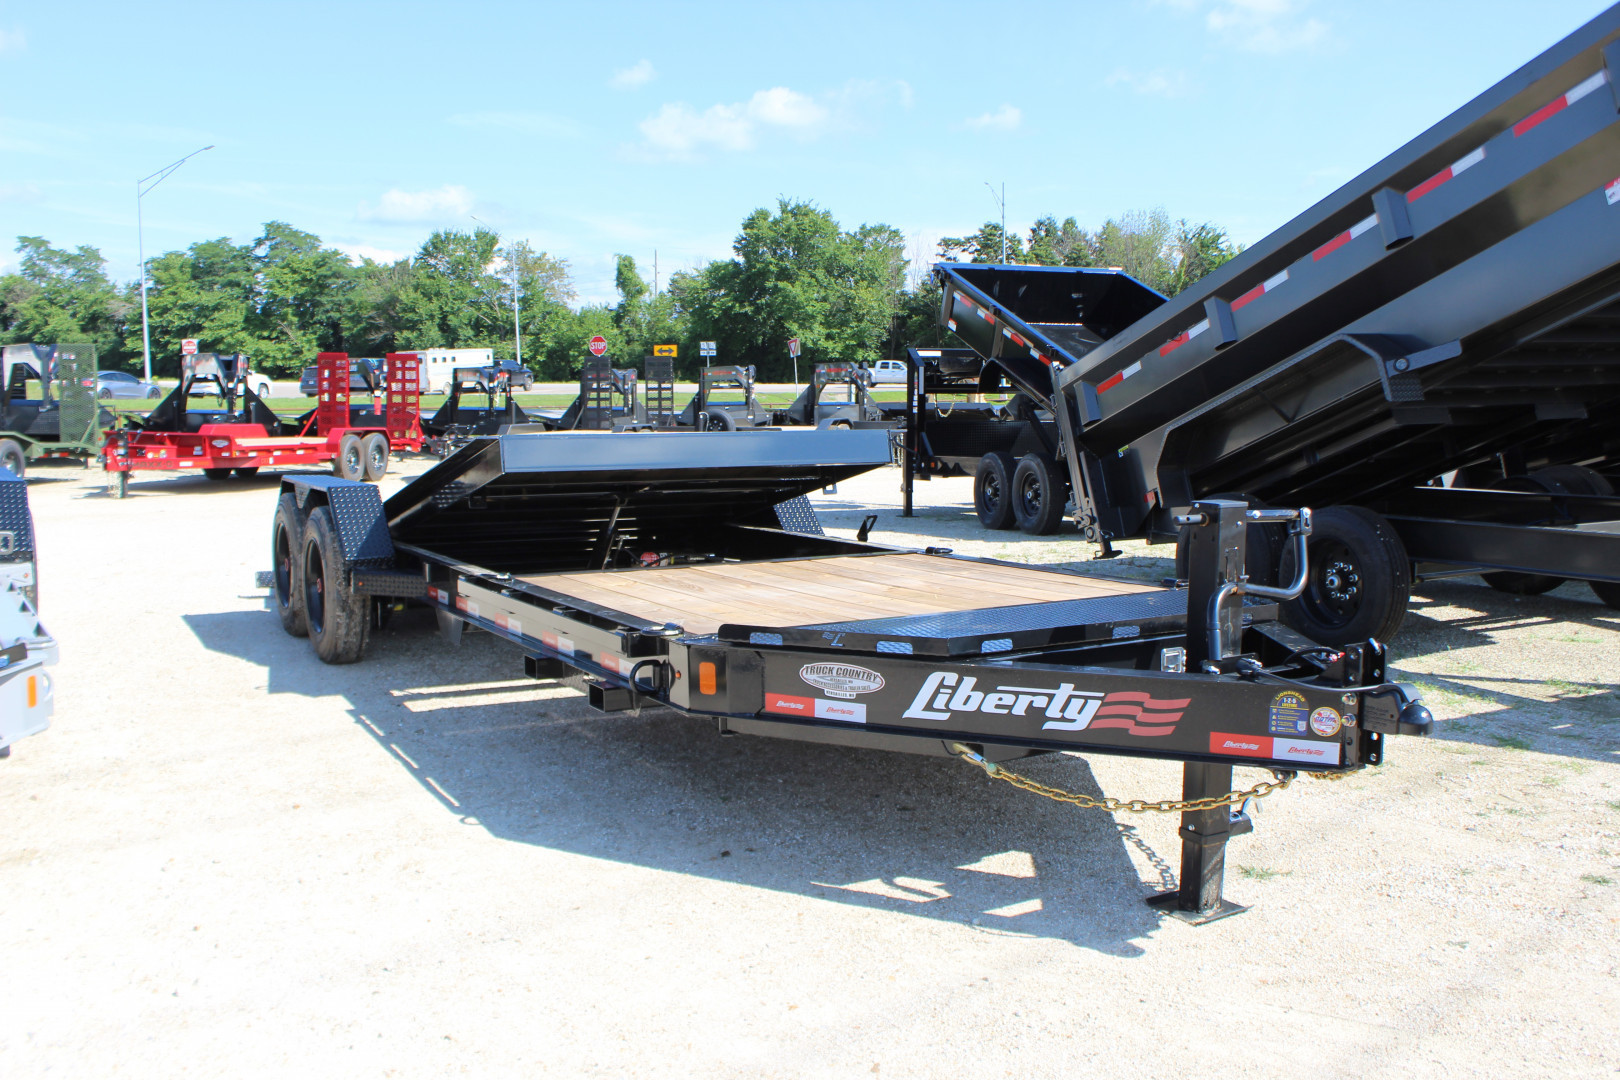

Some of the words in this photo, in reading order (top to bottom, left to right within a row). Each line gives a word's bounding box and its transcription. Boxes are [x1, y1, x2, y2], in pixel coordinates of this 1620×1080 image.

[804, 665, 835, 676] TRUCK
[835, 666, 880, 682] COUNTRY
[902, 671, 1105, 731] Liberty
[1223, 740, 1249, 749] Liberty
[1287, 746, 1314, 755] Liberty
